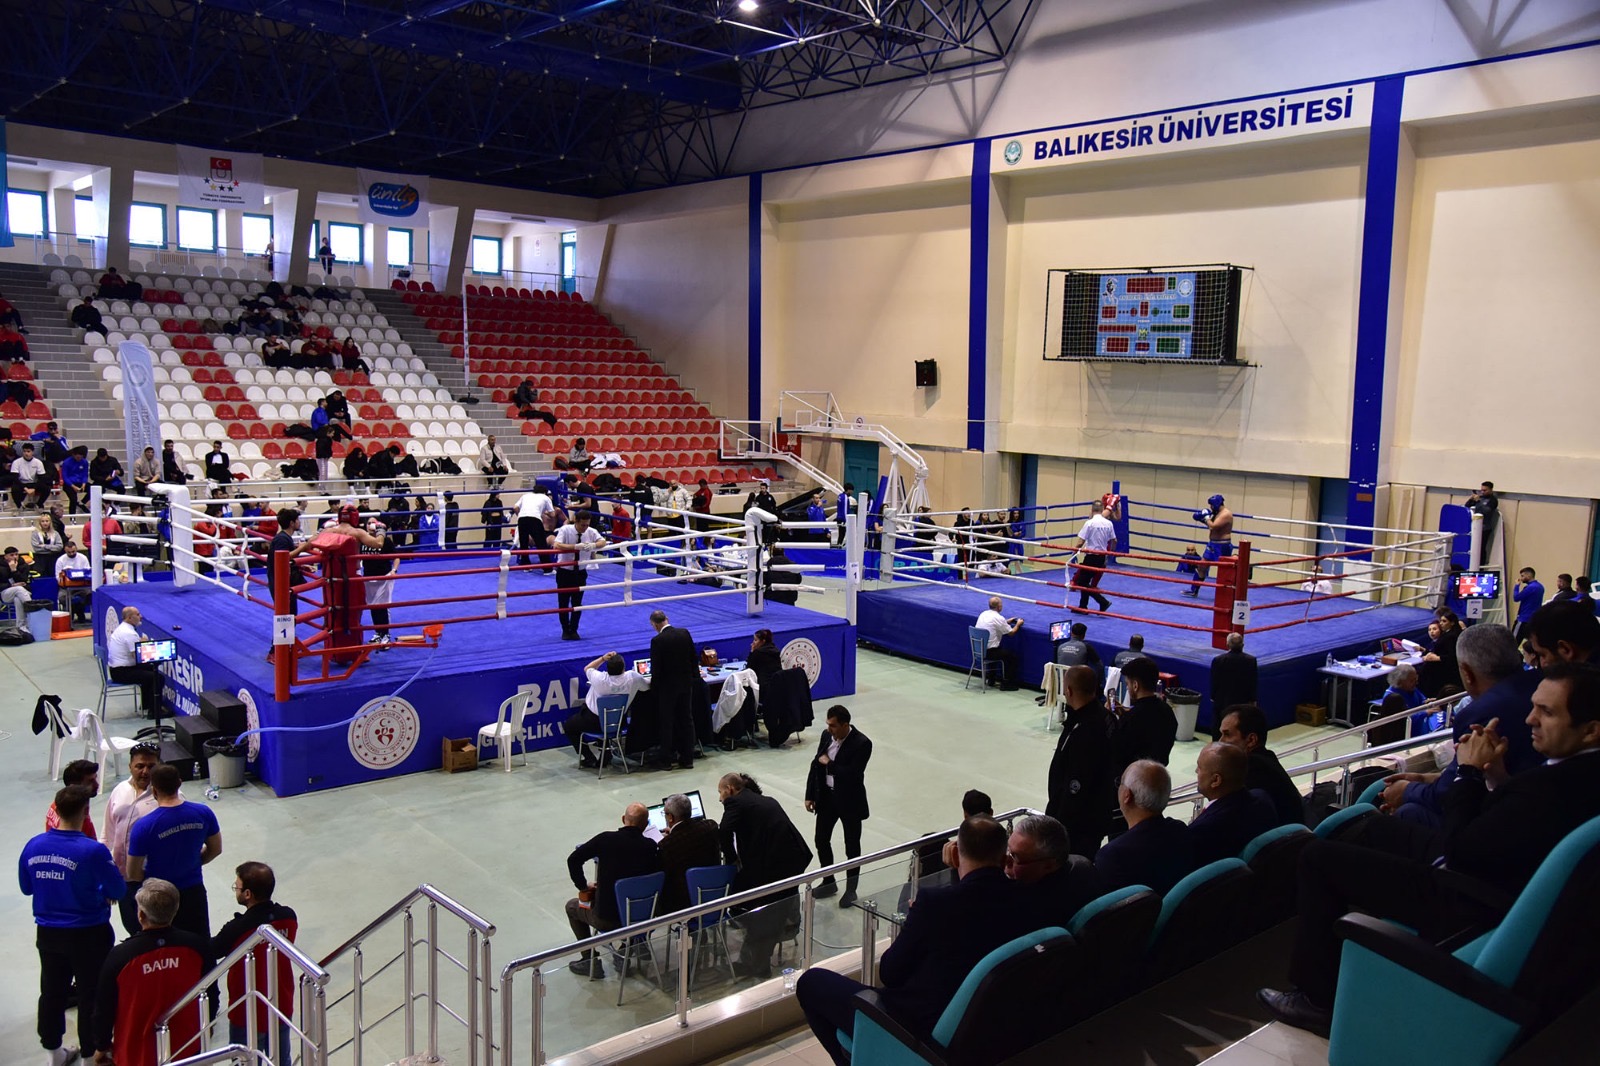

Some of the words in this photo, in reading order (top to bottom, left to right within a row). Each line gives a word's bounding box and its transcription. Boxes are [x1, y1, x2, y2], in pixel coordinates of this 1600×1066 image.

[1034, 120, 1153, 160] BALIKESİR
[1158, 88, 1354, 143] ÜNİVERSİTESİ
[1238, 611, 1245, 620] 2
[280, 628, 287, 639] 1
[36, 870, 65, 880] DENİZLİ
[143, 957, 179, 974] BAUN
